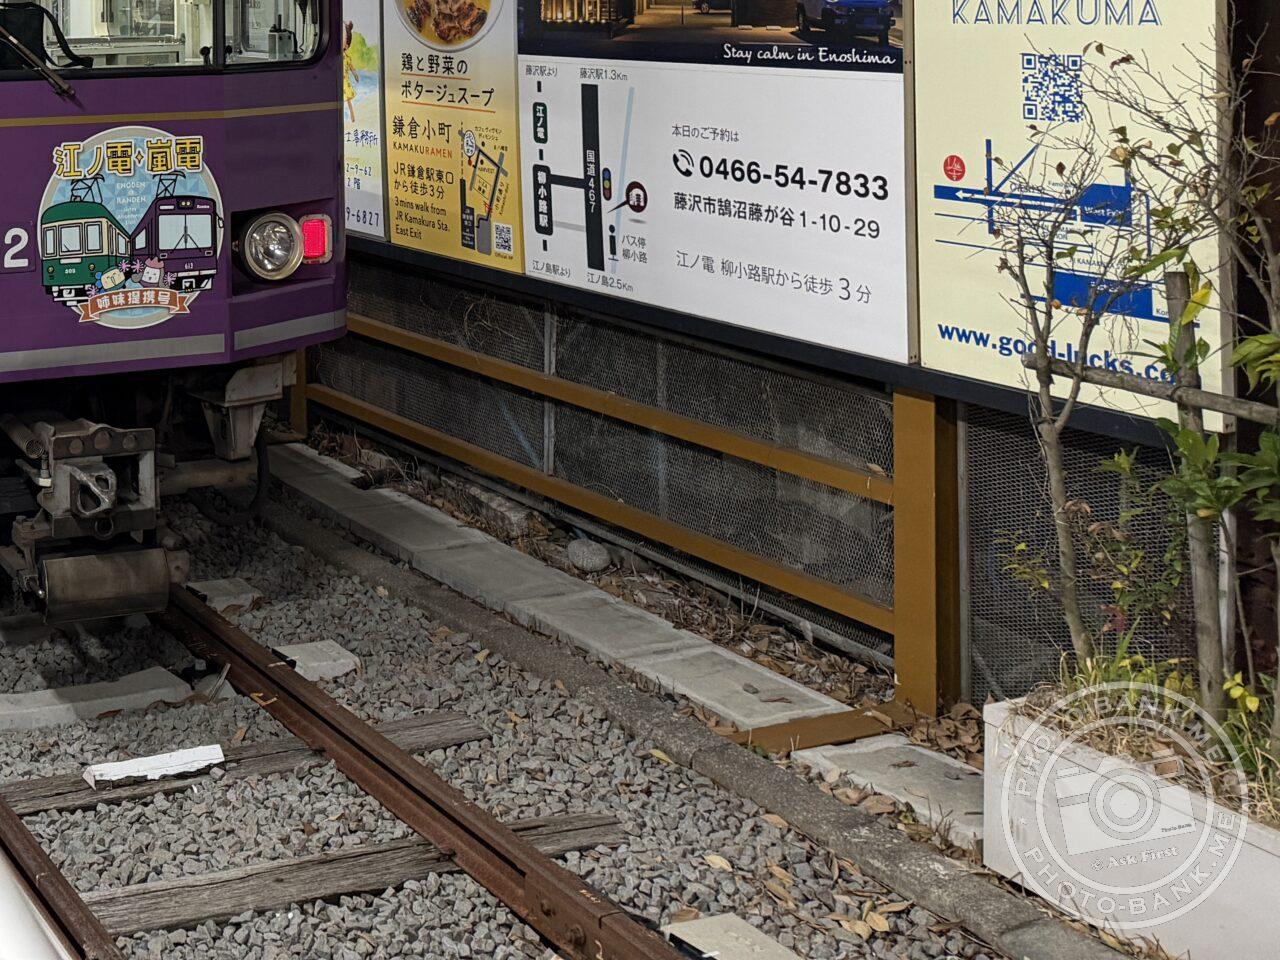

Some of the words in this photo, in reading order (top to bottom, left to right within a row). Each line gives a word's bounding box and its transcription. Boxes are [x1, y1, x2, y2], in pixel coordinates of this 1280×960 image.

[402, 53, 468, 75] 鶏と野菜の
[723, 43, 752, 62] Stay
[757, 44, 793, 61] calm
[797, 48, 815, 62] in
[817, 47, 896, 65] Enoshima
[526, 65, 558, 77] 藤沢駅より
[402, 81, 494, 107] ポタージュスープ
[393, 115, 452, 144] 鎌倉小町
[536, 105, 545, 139] 江ノ電
[671, 124, 740, 142] 本日のご予約は
[54, 141, 134, 178] 江ノ電
[145, 136, 203, 173] 嵐電
[393, 141, 453, 159] KAMAKURAMEN
[394, 162, 454, 185] JR鎌倉駅東口
[586, 149, 596, 213] 国道467
[699, 155, 889, 201] 0466-54-7833
[394, 178, 445, 200] から徒歩3分
[537, 170, 549, 227] 柳小路駅
[394, 196, 399, 206] 3
[400, 199, 414, 210] mins
[415, 202, 430, 213] walk
[431, 203, 447, 216] from
[673, 192, 795, 227] 藤沢市鵠沼藤が谷
[800, 210, 880, 239] 1-10-29
[395, 210, 404, 221] JR
[404, 212, 435, 228] Kamakura
[437, 220, 450, 231] Sta.
[395, 224, 409, 237] East
[410, 227, 422, 240] Exit
[622, 235, 646, 249] バス停
[622, 248, 648, 264] 柳小路
[532, 260, 571, 278] 江ノ島駅より
[676, 250, 715, 273] 江ノ電
[721, 258, 833, 296] 柳小路駅から徒歩
[587, 272, 634, 292] 江ノ島2.5Km
[96, 292, 171, 310] 姉妹提携号
